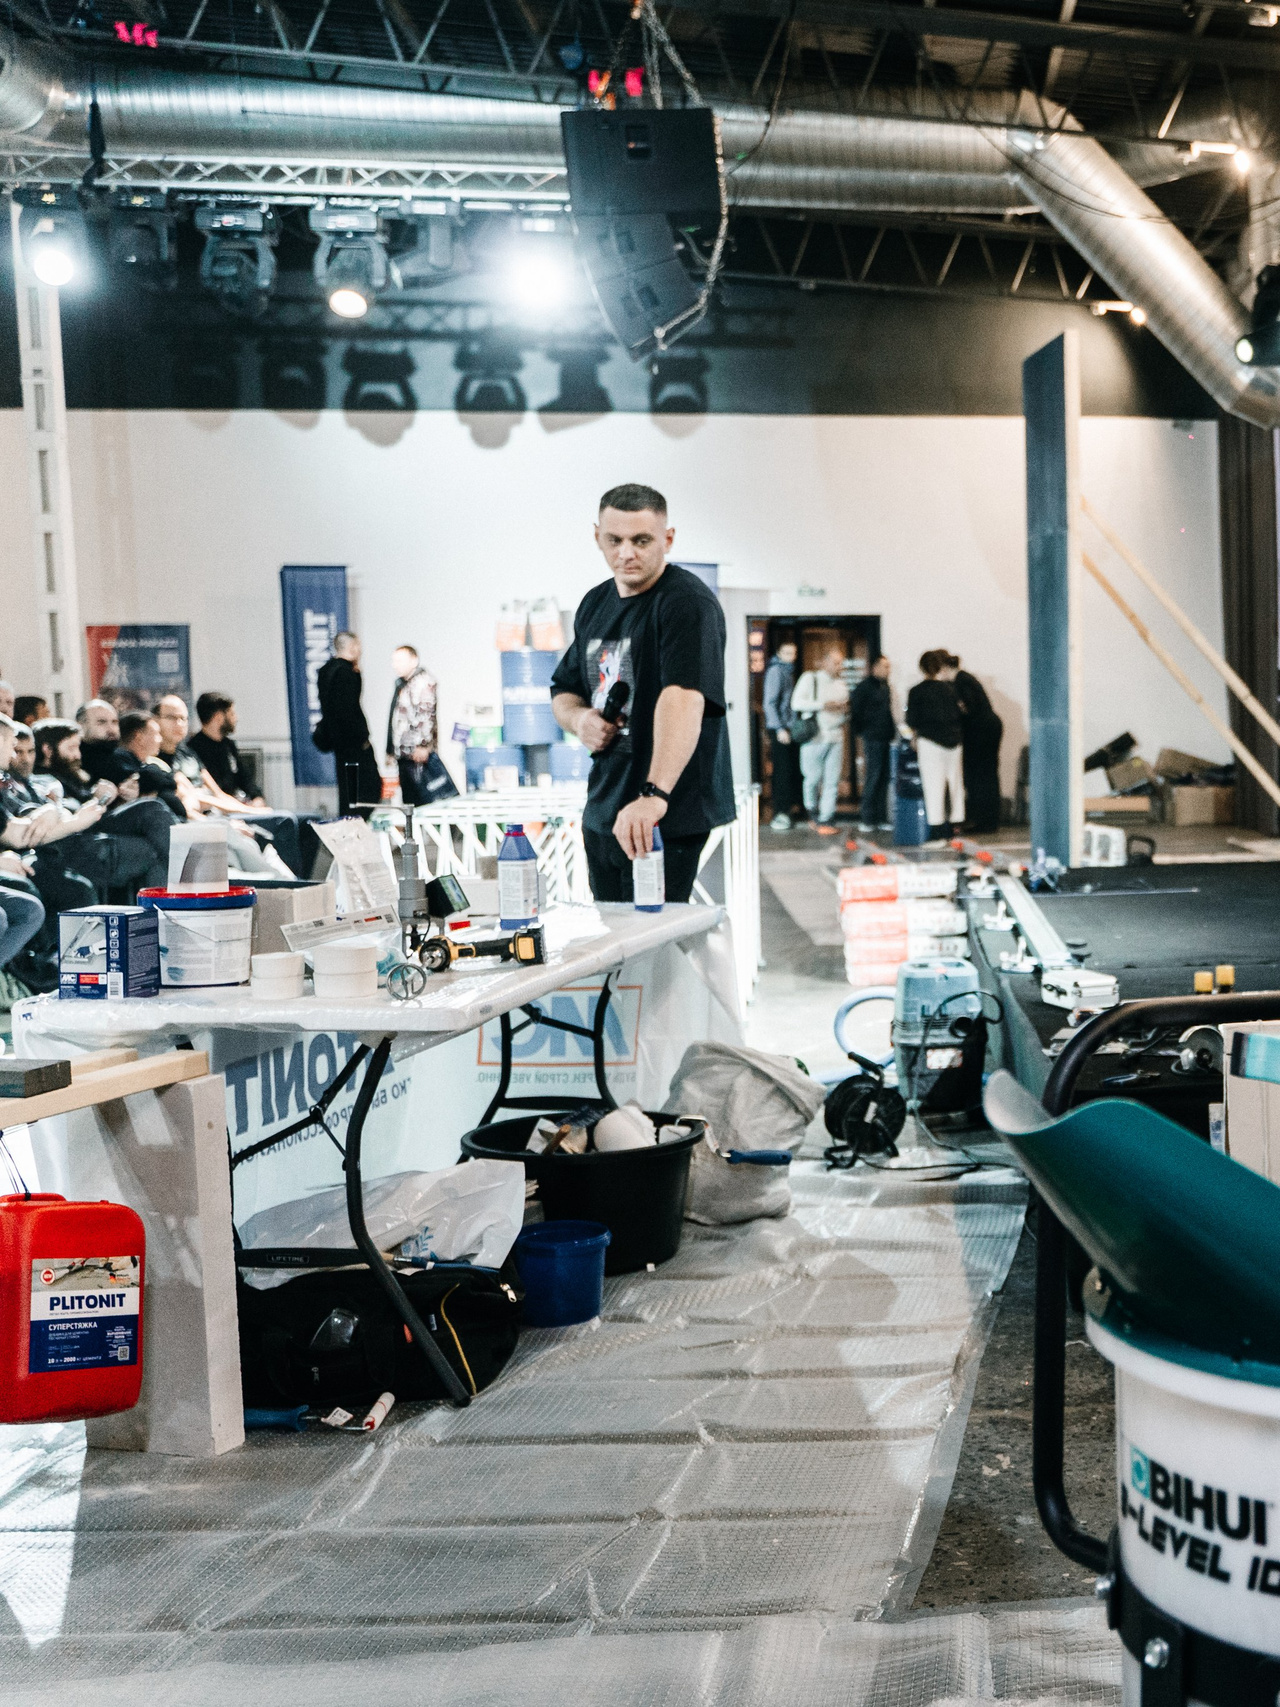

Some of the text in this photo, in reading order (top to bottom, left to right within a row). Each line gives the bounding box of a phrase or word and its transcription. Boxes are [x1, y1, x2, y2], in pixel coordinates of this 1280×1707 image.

[49, 1293, 126, 1311] PLITONIT
[48, 1321, 98, 1331] СУПЕРСТЯЖКА
[1149, 1459, 1268, 1546] BIHUI
